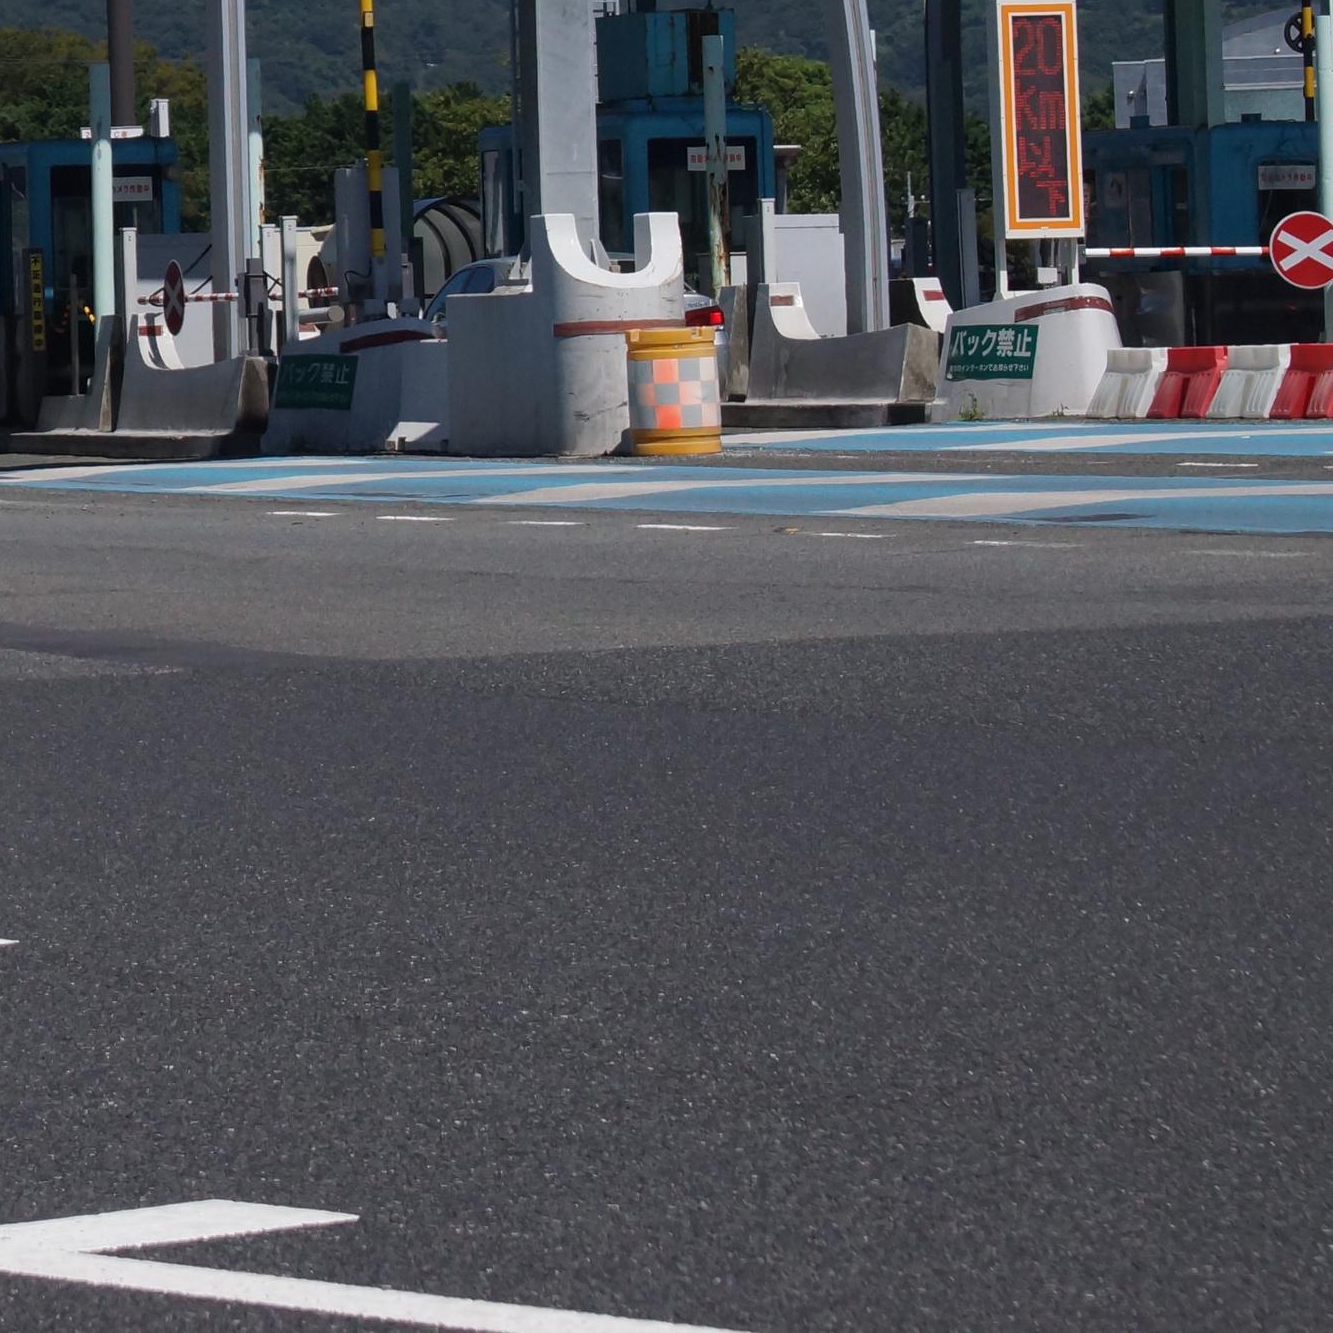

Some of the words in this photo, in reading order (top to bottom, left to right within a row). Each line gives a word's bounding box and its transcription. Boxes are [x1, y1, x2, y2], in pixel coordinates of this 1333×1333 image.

[1013, 18, 1062, 75] 20
[952, 328, 1032, 358] バック禁止
